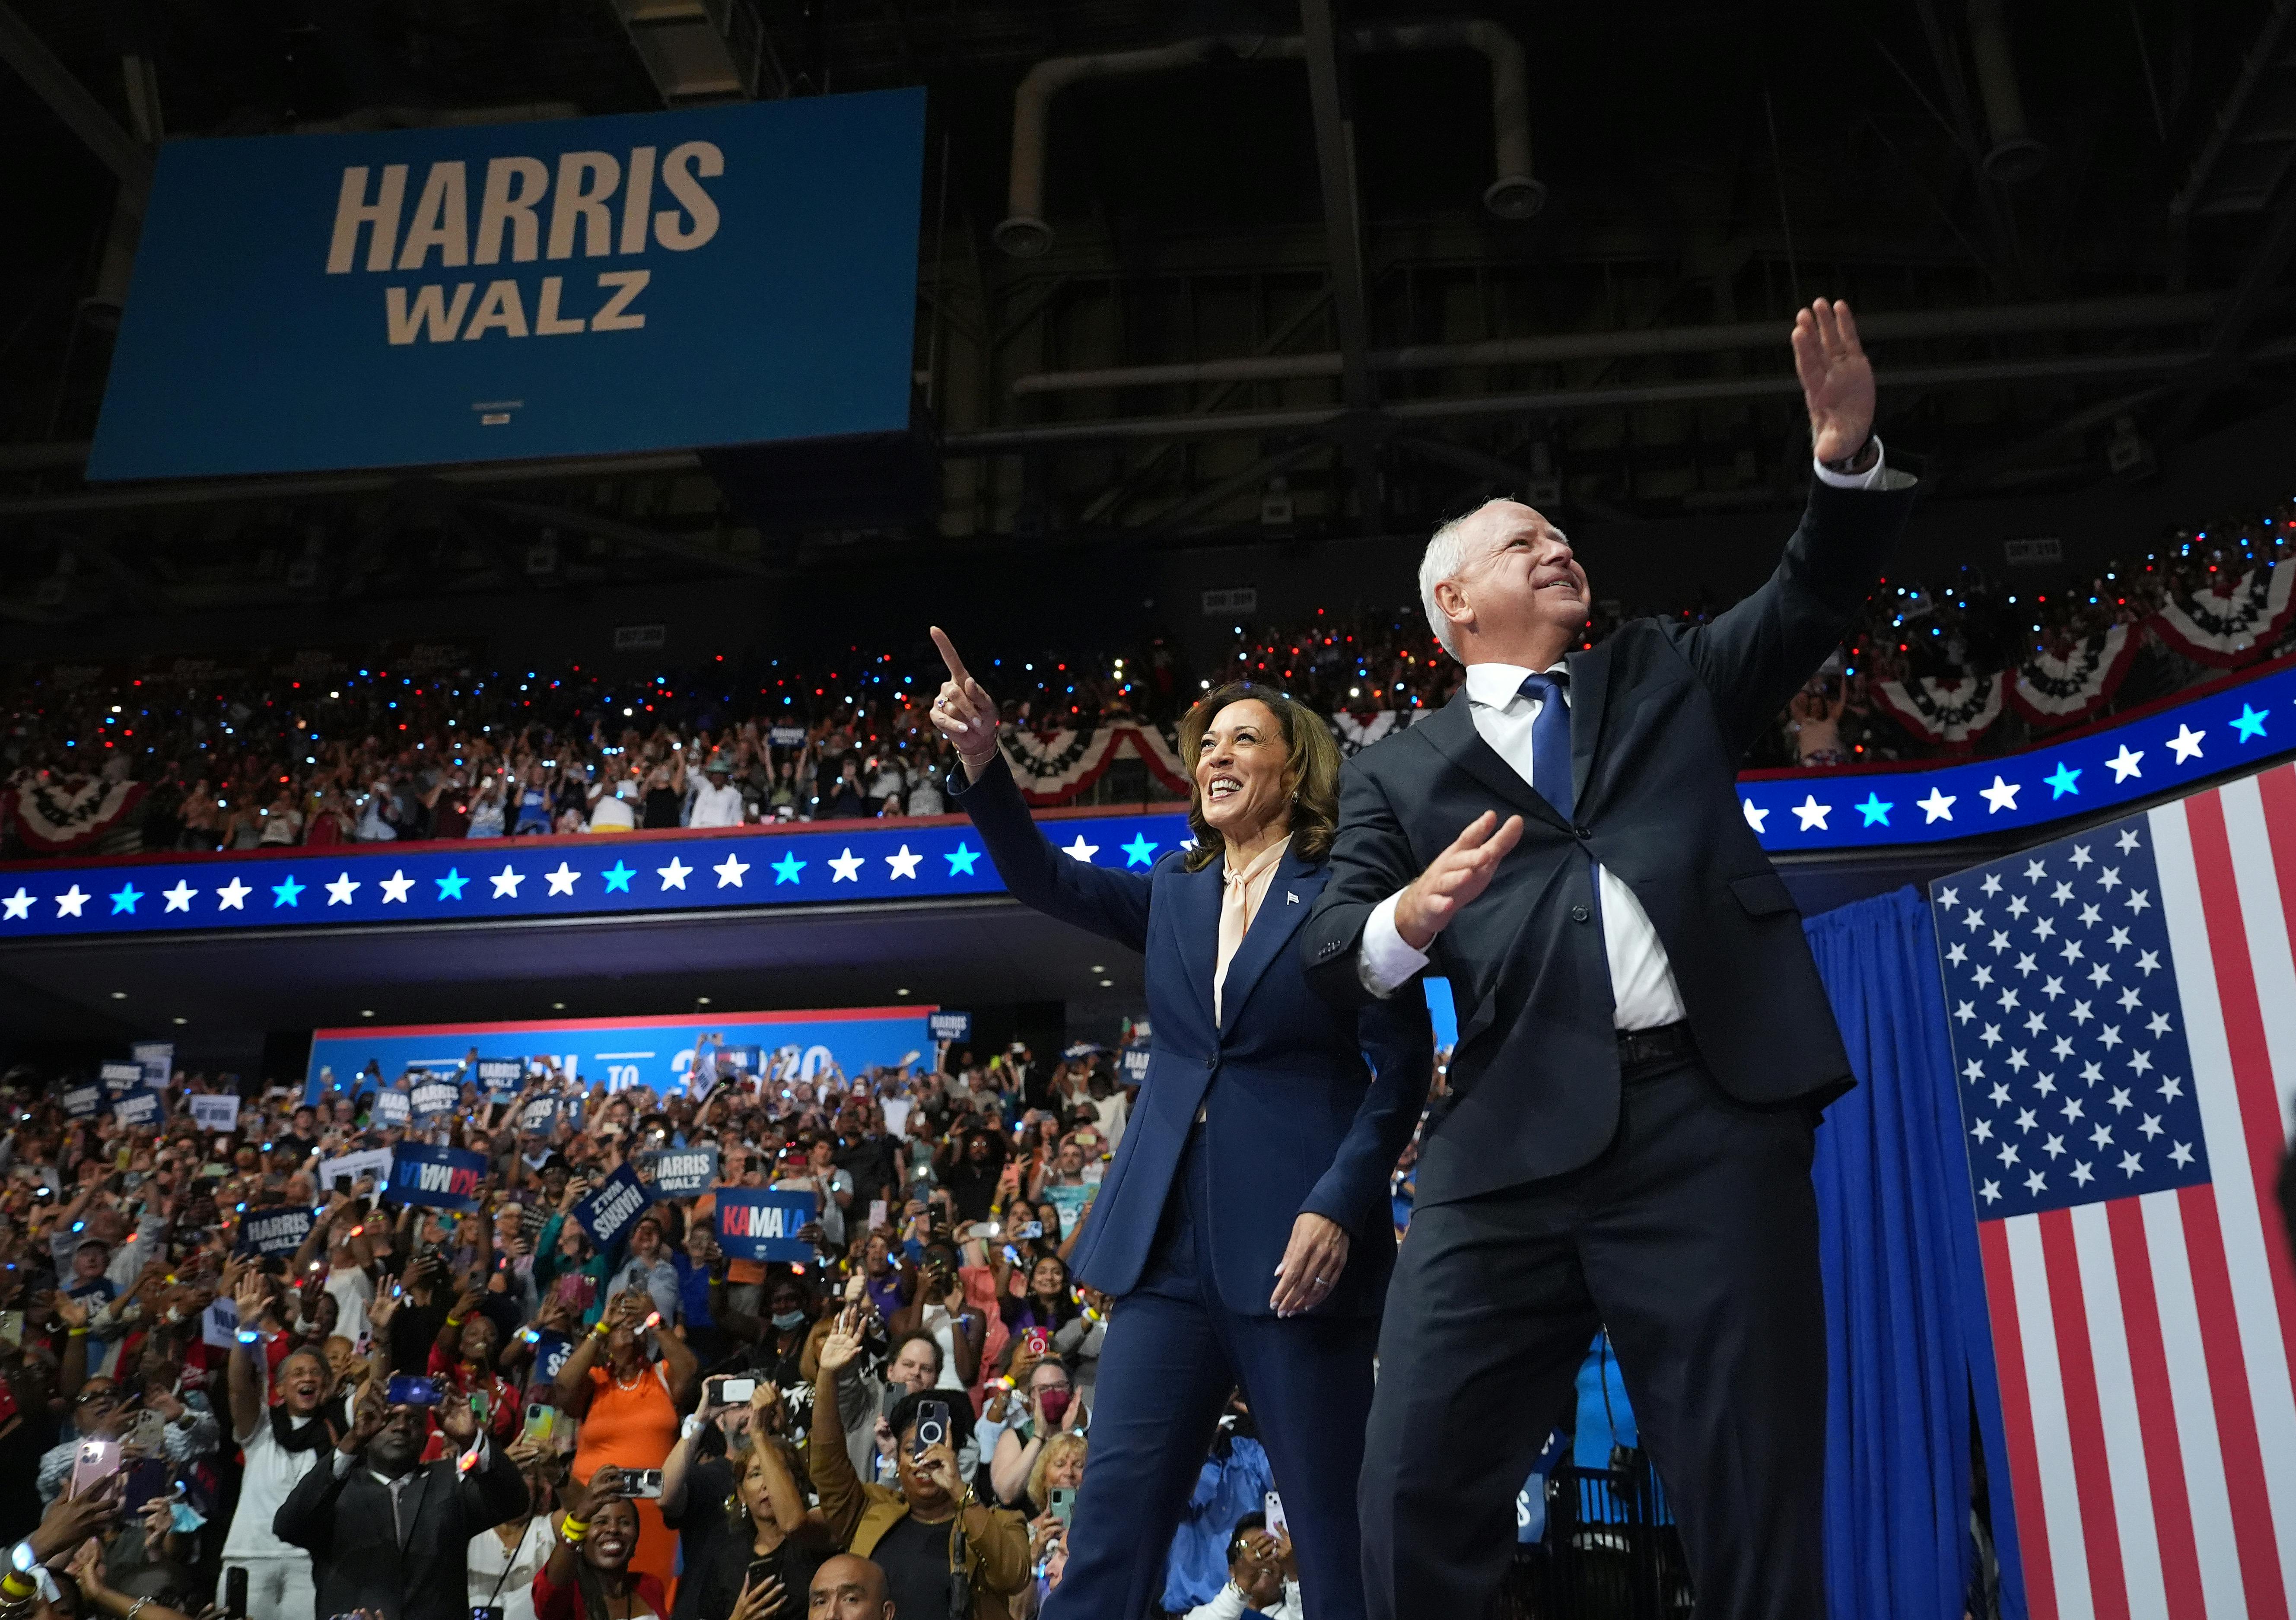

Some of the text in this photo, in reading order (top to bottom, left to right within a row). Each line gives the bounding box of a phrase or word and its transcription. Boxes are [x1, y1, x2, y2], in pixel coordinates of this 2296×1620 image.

[325, 141, 725, 275] HARRIS
[385, 270, 651, 346] WALZ
[478, 1063, 521, 1080] HARRIS
[411, 1083, 459, 1105] HARRIS
[419, 1099, 453, 1114] WALZ
[590, 1179, 625, 1216] WALZ
[659, 1175, 702, 1192] WALZ
[248, 1212, 311, 1242] HARRIS
[592, 1184, 644, 1241] HARRIS
[723, 1204, 805, 1238] KAMALA
[259, 1234, 302, 1253] WALZ
